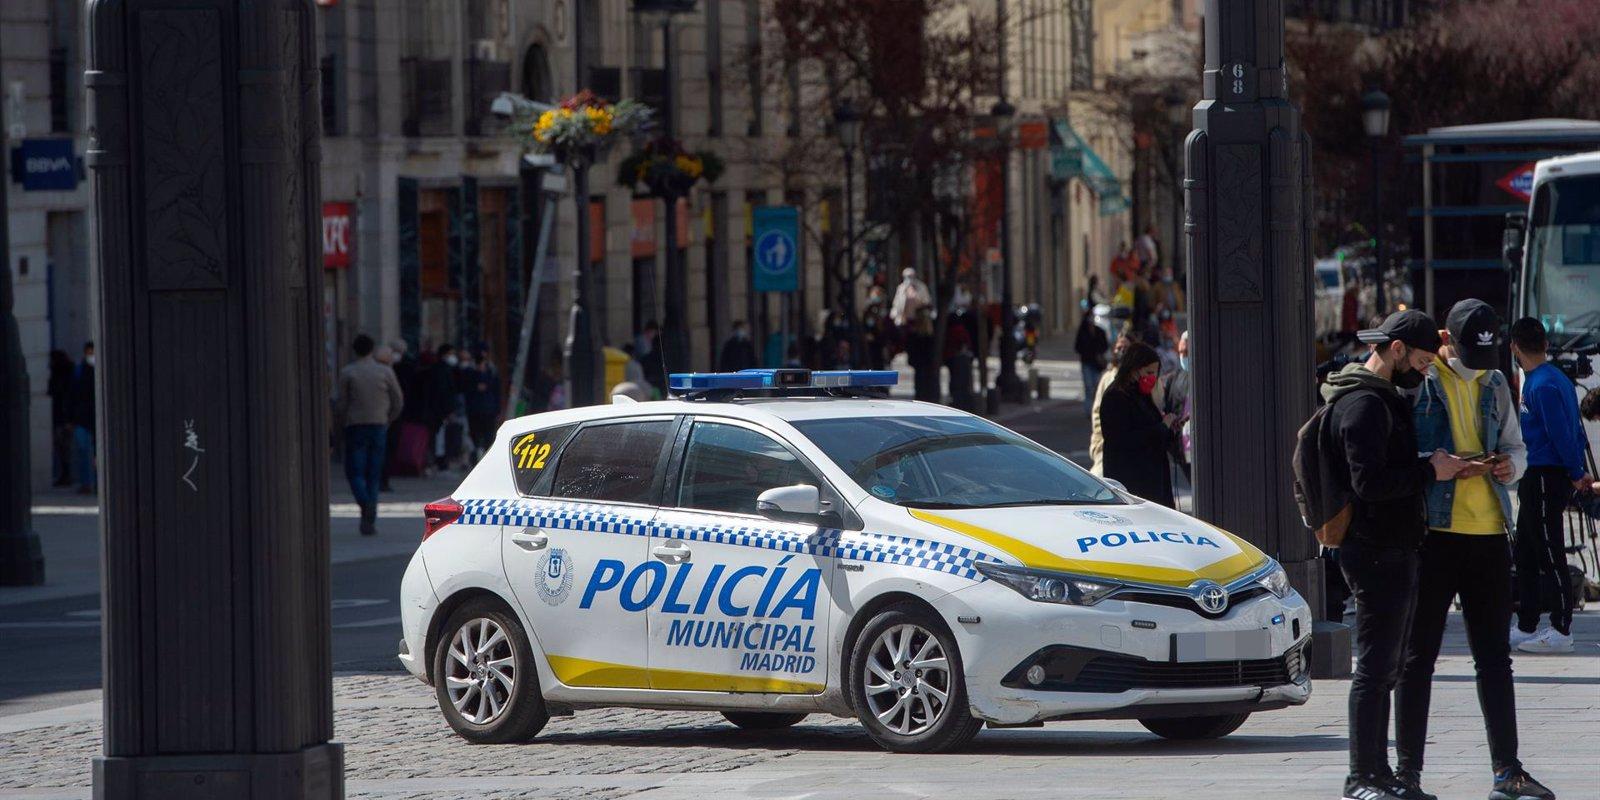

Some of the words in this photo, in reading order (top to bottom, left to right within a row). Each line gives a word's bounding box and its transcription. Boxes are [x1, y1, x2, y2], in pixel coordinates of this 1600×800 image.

[26, 157, 71, 173] BBVA
[517, 443, 551, 469] 112
[579, 554, 822, 621] POLICÍA
[666, 619, 816, 653] MUNICIPAL
[740, 653, 816, 674] MADRID
